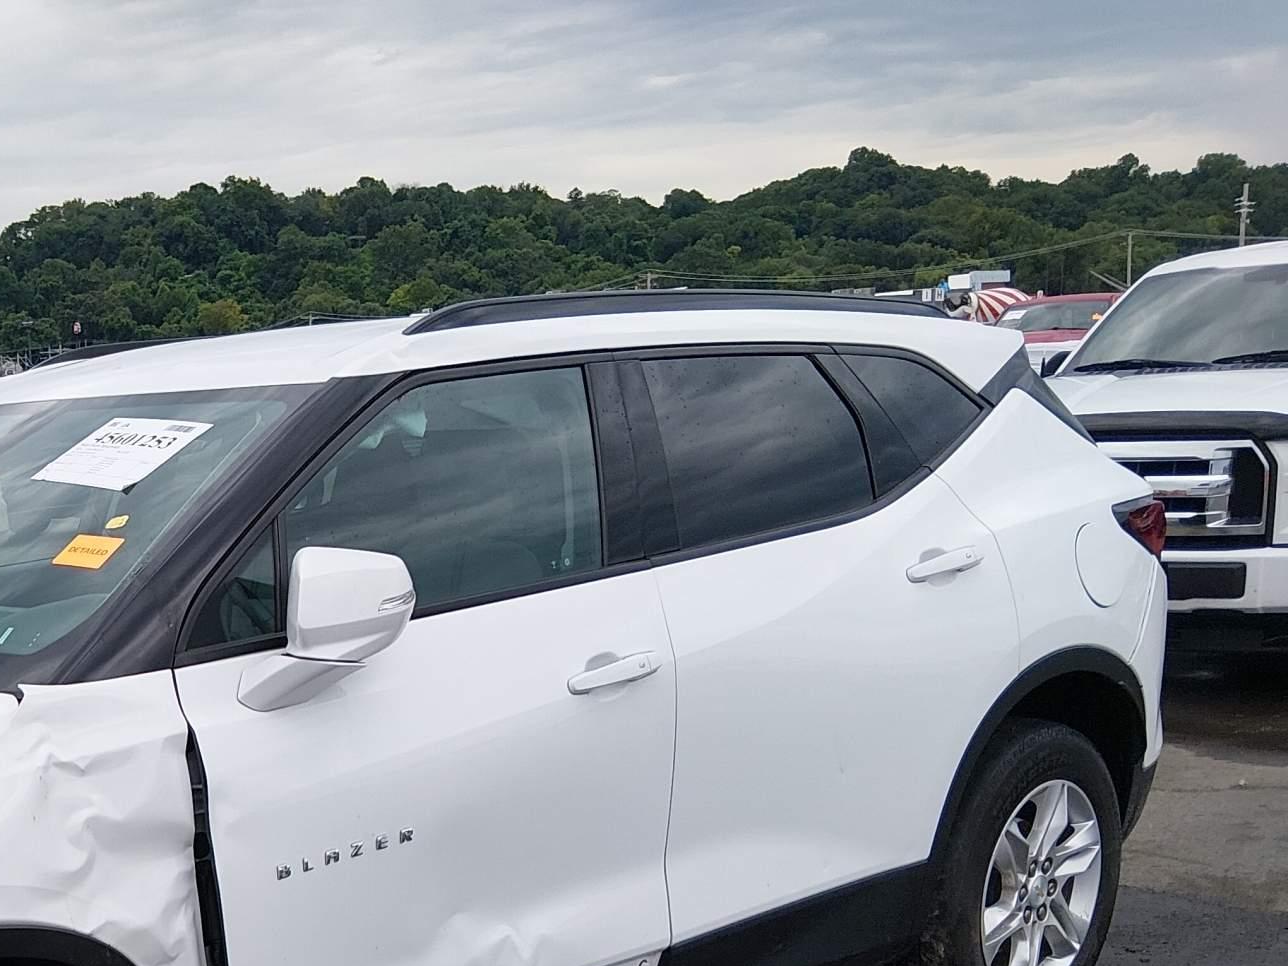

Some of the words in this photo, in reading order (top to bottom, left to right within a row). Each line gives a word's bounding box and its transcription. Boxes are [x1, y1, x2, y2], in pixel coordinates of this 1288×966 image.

[94, 432, 178, 449] 45601253
[67, 546, 109, 556] DETAILED
[276, 827, 414, 881] BLAZER
